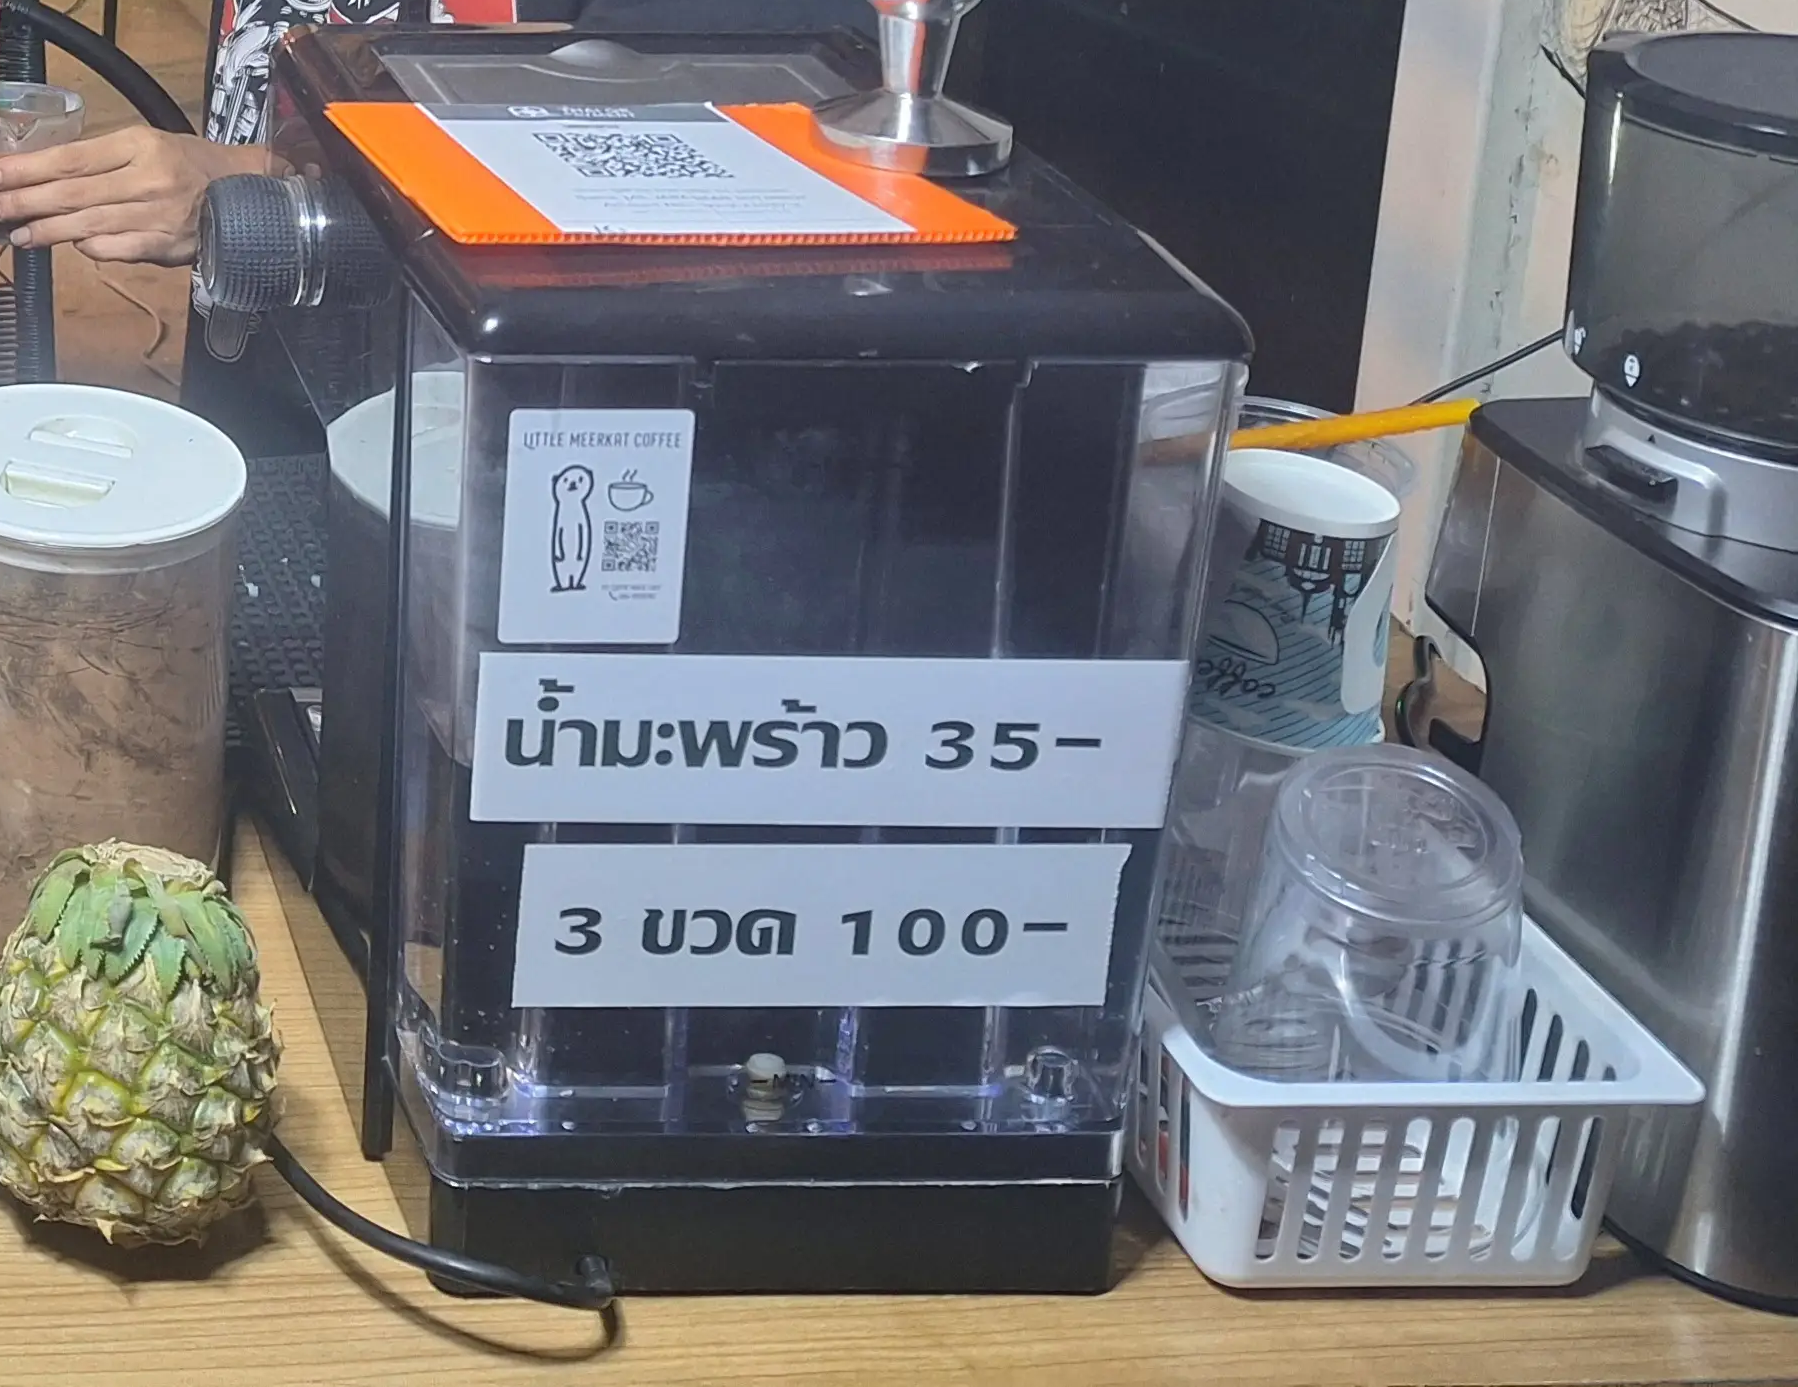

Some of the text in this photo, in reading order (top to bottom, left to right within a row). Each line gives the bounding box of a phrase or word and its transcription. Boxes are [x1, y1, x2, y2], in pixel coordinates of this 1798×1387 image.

[523, 431, 682, 450] LITTLE MEERKAT COFFEE
[503, 677, 891, 771] น้ำมะพร้าว
[554, 907, 603, 956] 3
[641, 908, 798, 957] ขวด
